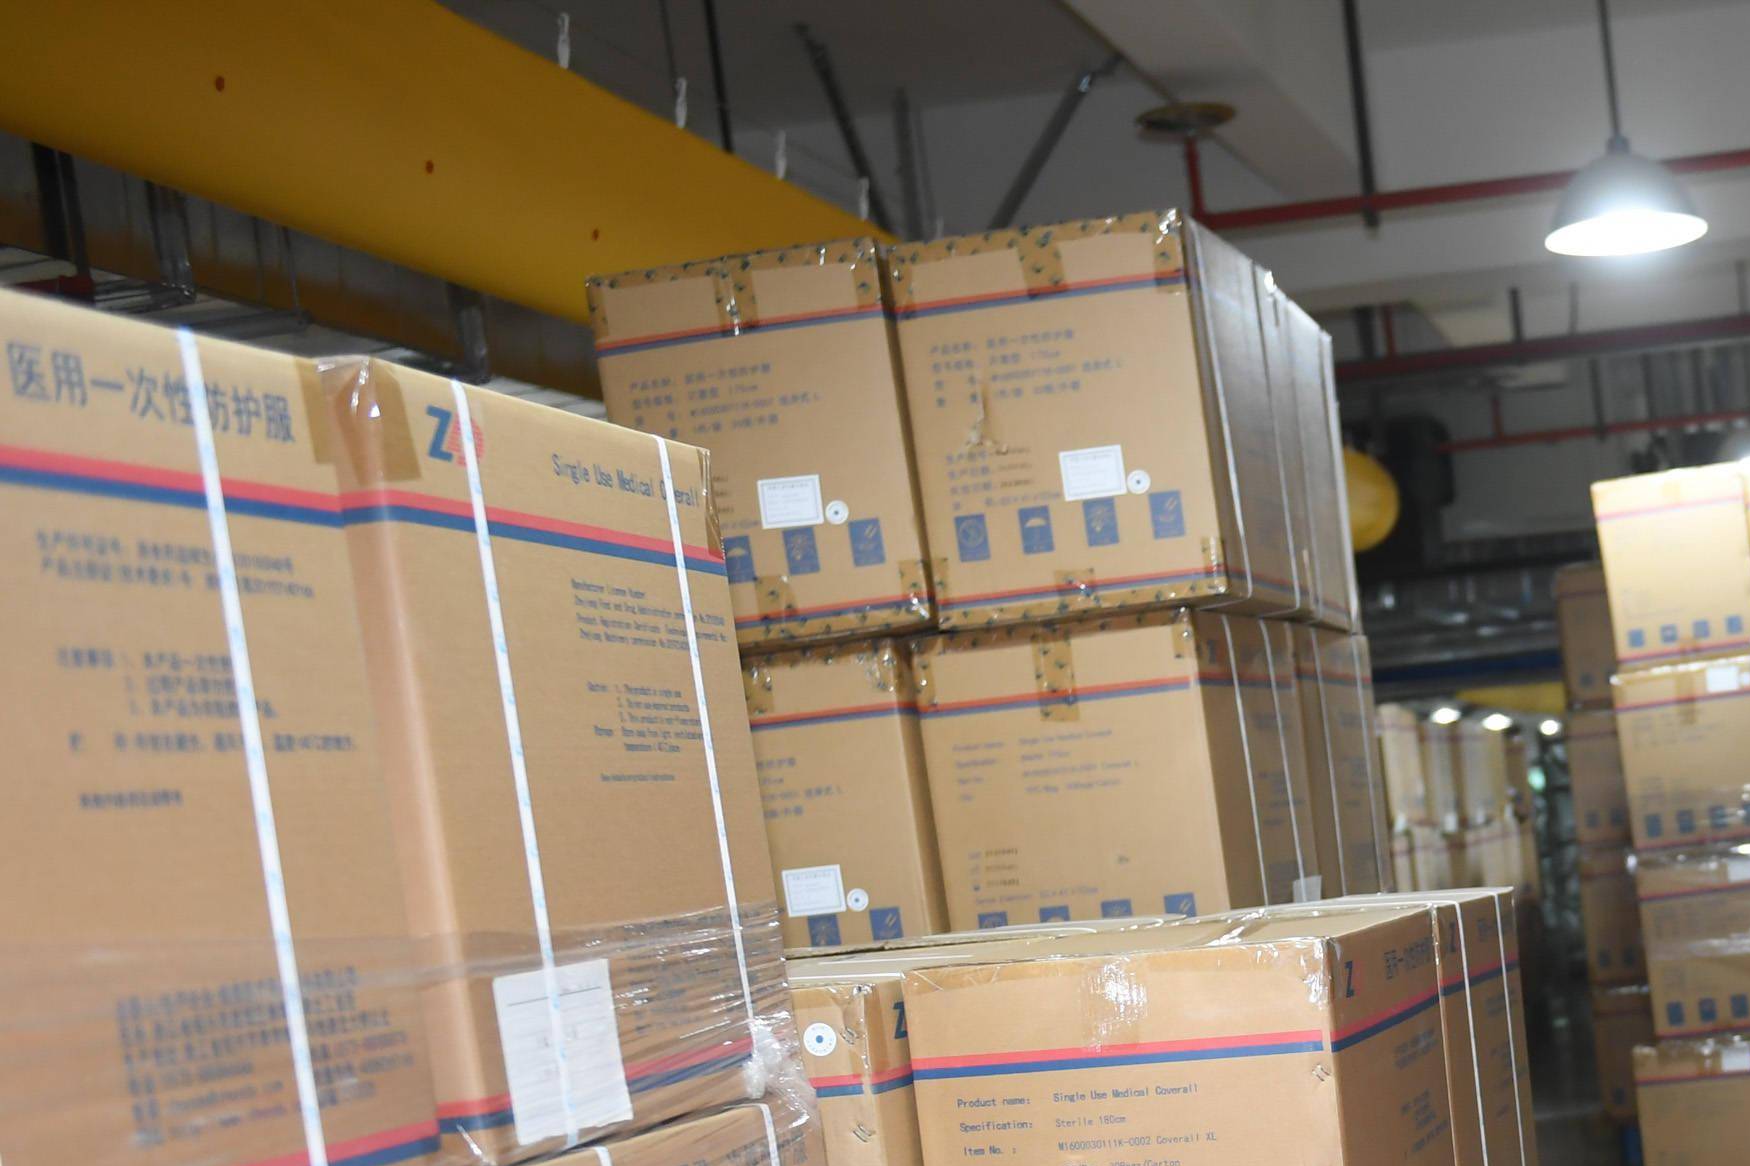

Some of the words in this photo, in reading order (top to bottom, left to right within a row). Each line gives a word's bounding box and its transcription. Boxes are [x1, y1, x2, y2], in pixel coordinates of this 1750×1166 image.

[957, 1096, 996, 1109] Product
[1002, 1096, 1031, 1107] name:
[1053, 1091, 1087, 1103] Single
[1090, 1089, 1108, 1100] Use
[1111, 1086, 1150, 1099] Medical
[1155, 1083, 1199, 1097] Coverall
[959, 1120, 1034, 1134] Specification:
[1055, 1116, 1095, 1129] Sterile
[964, 1146, 986, 1157] Item
[1156, 1131, 1200, 1145] Coverall
[1205, 1131, 1217, 1142] XL
